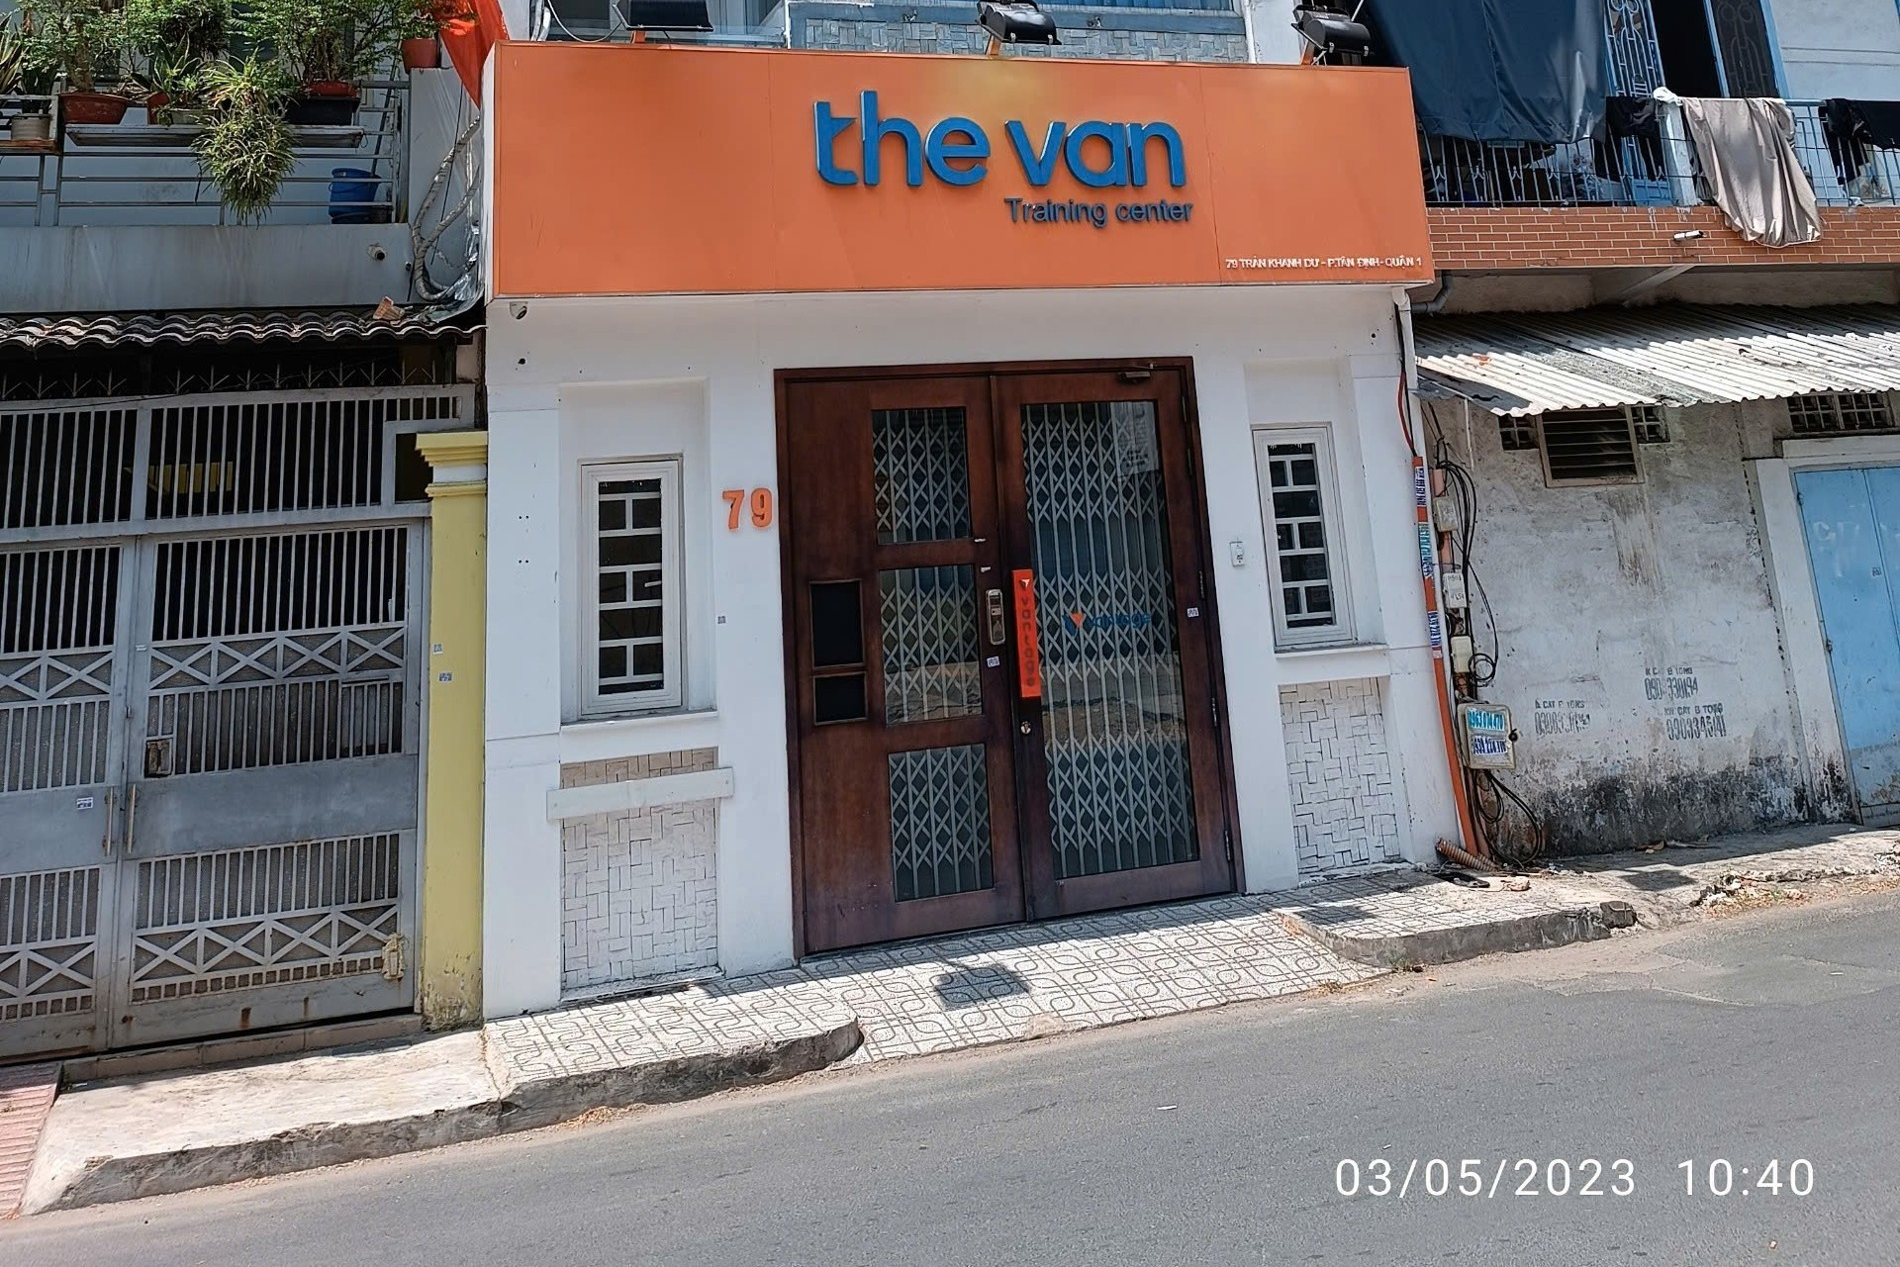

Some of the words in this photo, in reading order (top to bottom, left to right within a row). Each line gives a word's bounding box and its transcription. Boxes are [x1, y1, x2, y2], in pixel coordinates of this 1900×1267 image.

[813, 90, 991, 186] the
[1004, 120, 1187, 187] van
[1004, 197, 1107, 228] Training
[1114, 199, 1193, 223] center
[1225, 258, 1238, 269] 79
[722, 488, 773, 530] 79
